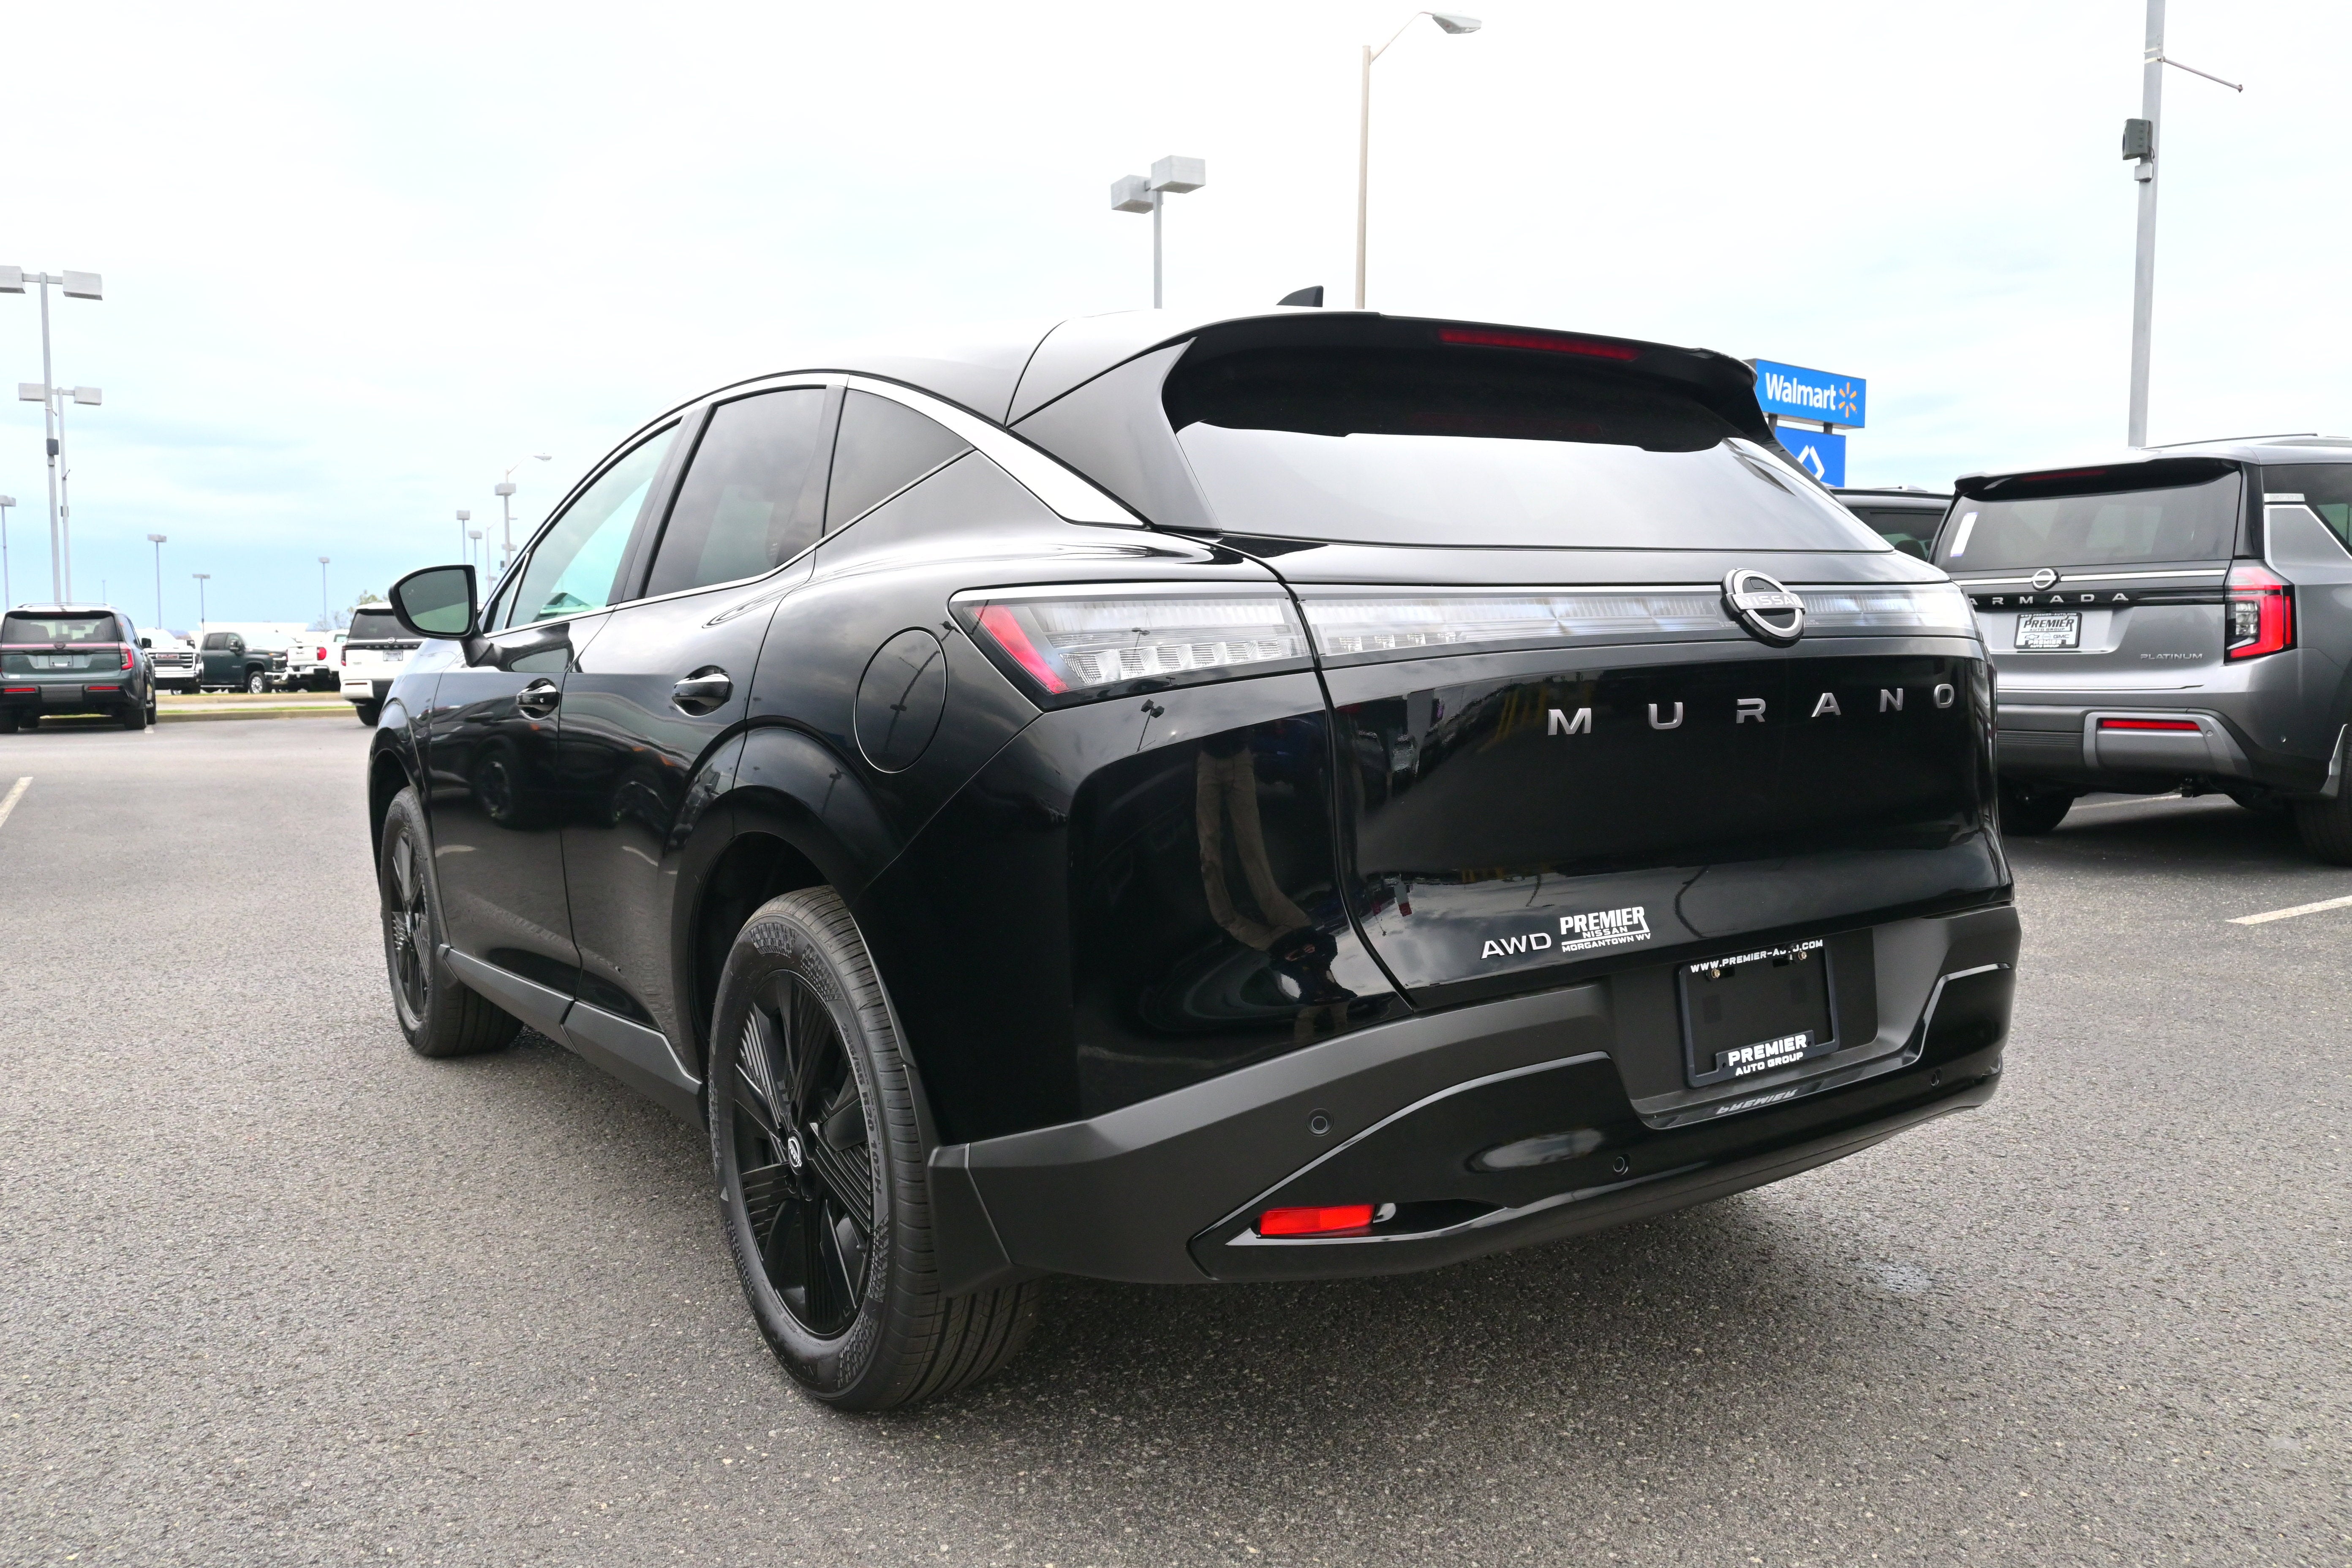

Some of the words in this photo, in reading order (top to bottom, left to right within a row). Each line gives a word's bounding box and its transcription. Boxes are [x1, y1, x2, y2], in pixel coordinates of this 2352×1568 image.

[1765, 372, 1836, 411] Walmart
[1737, 595, 1804, 606] NISSAN
[2023, 619, 2074, 629] PREMIER
[1548, 684, 1955, 735] MURANO
[1560, 906, 1650, 934] PREMIER
[1582, 926, 1628, 939] NISSAN
[1480, 932, 1552, 959] AWD
[1562, 935, 1634, 953] MORGANTOWN
[1635, 933, 1651, 941] WV
[1690, 939, 1823, 972] WWW.PREMIER-AUO.COM
[1728, 1034, 1807, 1067] PREMIER
[1735, 1062, 1765, 1076] AUTO
[1767, 1051, 1804, 1067] GROUP
[862, 1092, 874, 1132] R20
[871, 1140, 882, 1194] 107H
